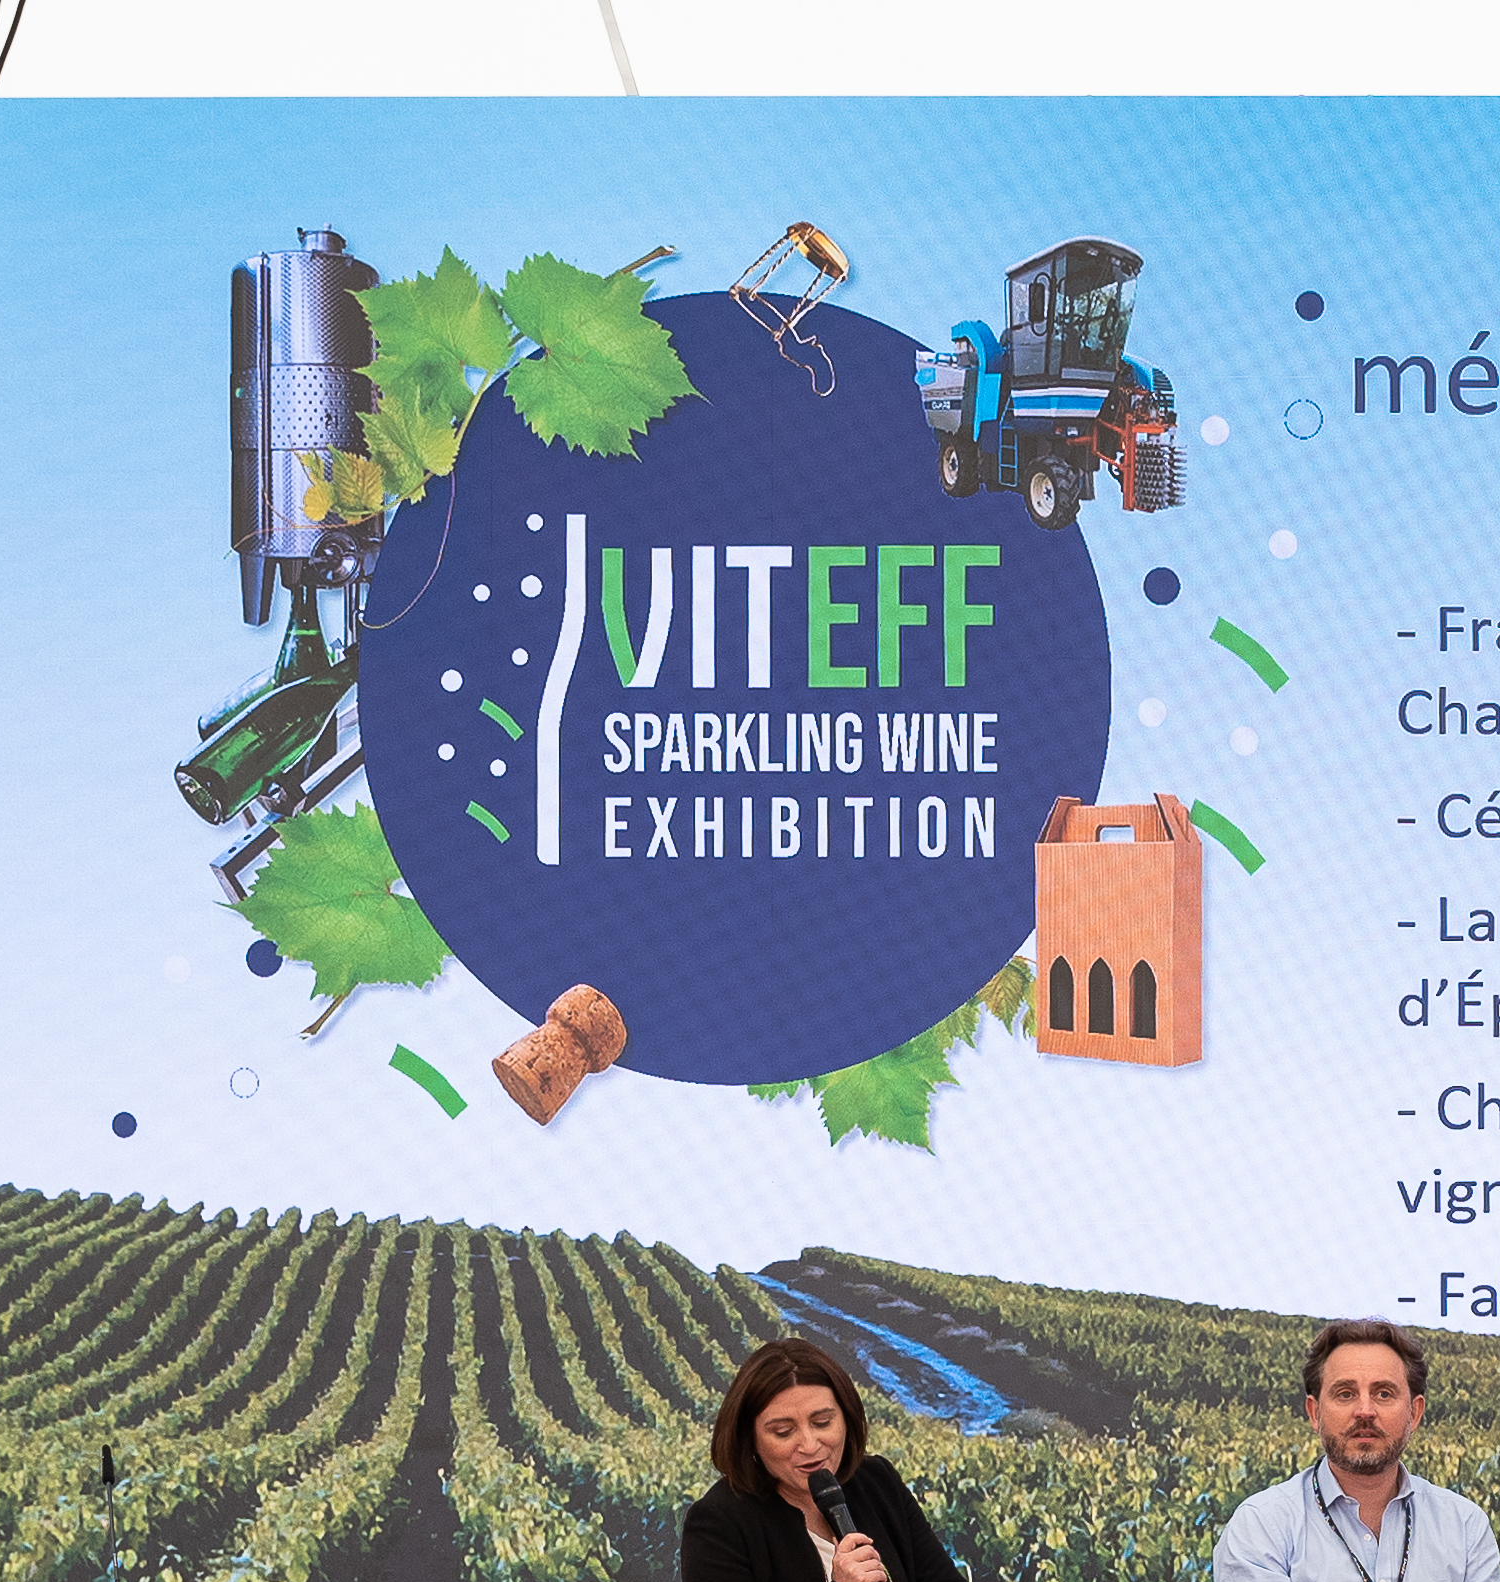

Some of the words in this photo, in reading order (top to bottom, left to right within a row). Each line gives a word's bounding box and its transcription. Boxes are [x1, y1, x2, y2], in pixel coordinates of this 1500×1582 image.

[601, 545, 1000, 688] VITEFF
[604, 712, 862, 773] SPARKLING
[878, 713, 997, 772] WINE
[605, 796, 994, 858] EXHIBITION
